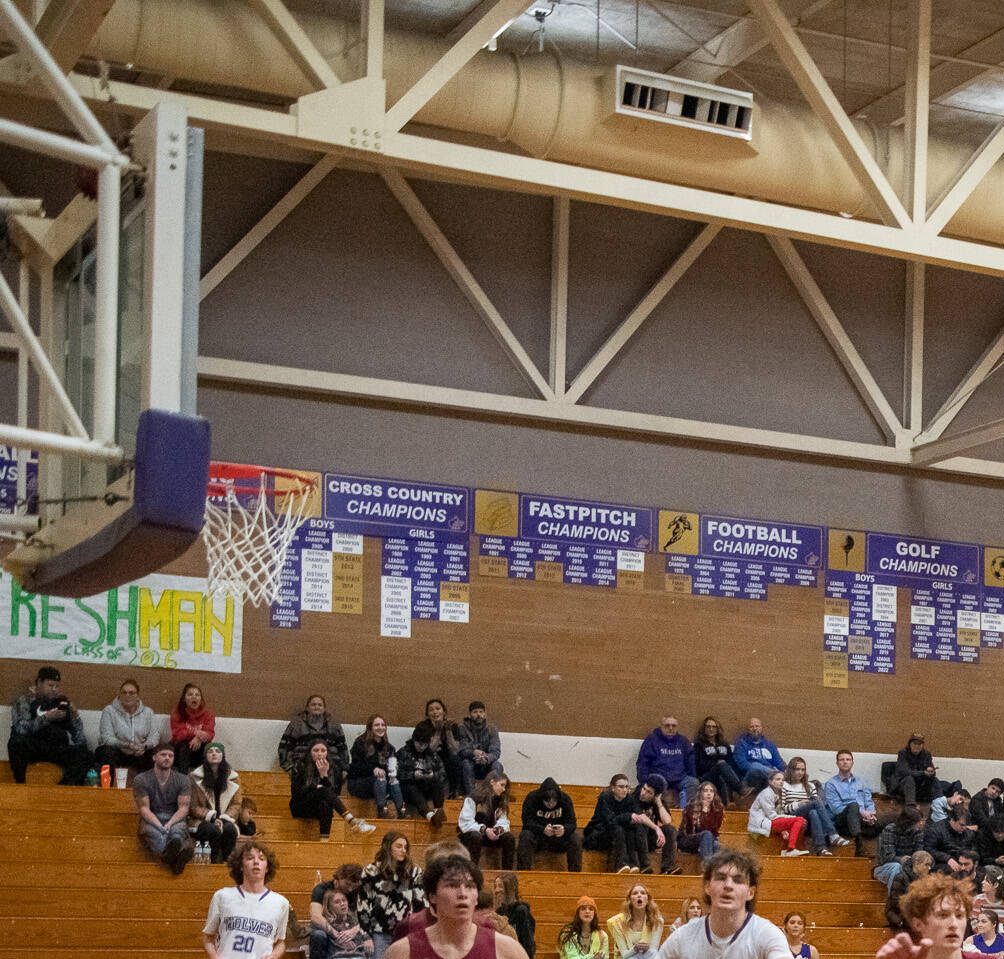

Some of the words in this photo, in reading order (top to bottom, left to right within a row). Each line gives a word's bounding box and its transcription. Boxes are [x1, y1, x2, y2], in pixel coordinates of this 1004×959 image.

[329, 481, 382, 497] CROSS
[388, 487, 463, 505] COUNTRY
[347, 500, 447, 522] CHAMPIONS
[530, 501, 636, 526] FASTPITCH
[310, 519, 335, 529] BOYS
[538, 522, 630, 542] CHAMPIONS
[708, 521, 802, 544] FOOTBALL
[410, 529, 435, 539] GIRLS
[713, 540, 798, 560] CHAMPIONS
[896, 542, 940, 558] GOLF
[880, 558, 958, 576] CHAMPIONS
[855, 574, 875, 582] BOYS
[932, 582, 952, 590] GIRLS
[5, 576, 234, 656] RESHMAN
[64, 644, 103, 658] CLASS
[106, 647, 125, 660] OF
[224, 916, 273, 938] WOLVES
[232, 935, 254, 953] 20
